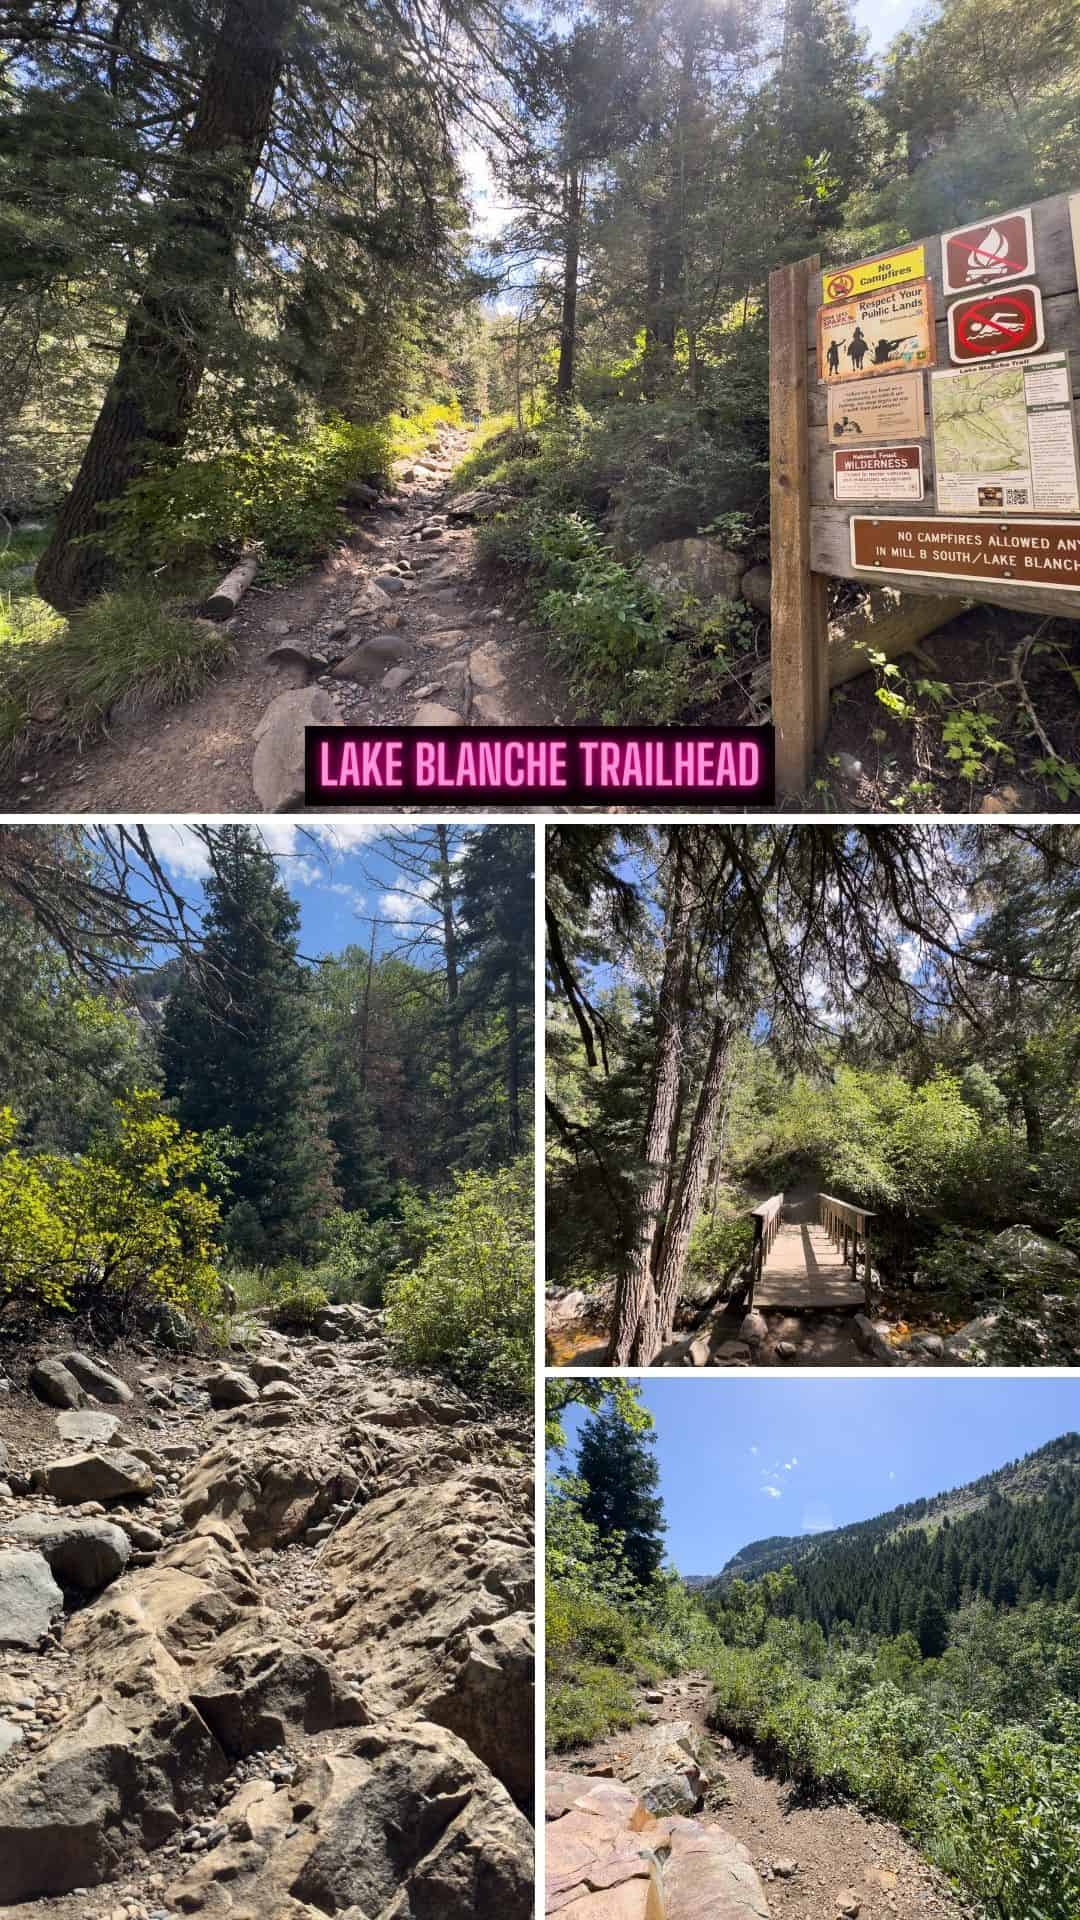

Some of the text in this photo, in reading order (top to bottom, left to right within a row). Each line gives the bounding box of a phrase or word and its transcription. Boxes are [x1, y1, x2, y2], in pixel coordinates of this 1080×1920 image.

[860, 265, 912, 286] Campfires
[878, 263, 892, 272] No
[859, 288, 922, 310] Respect Your
[861, 306, 889, 321] Public
[892, 299, 923, 312] Lands
[844, 458, 908, 470] WILDERNESS
[897, 531, 913, 543] NO
[917, 532, 983, 546] CAMPFIRES
[988, 535, 1050, 550] ALLOWED
[875, 546, 887, 556] IN
[891, 547, 916, 559] MILL
[919, 550, 928, 560] B
[932, 550, 1017, 568] SOUTH/LAKE
